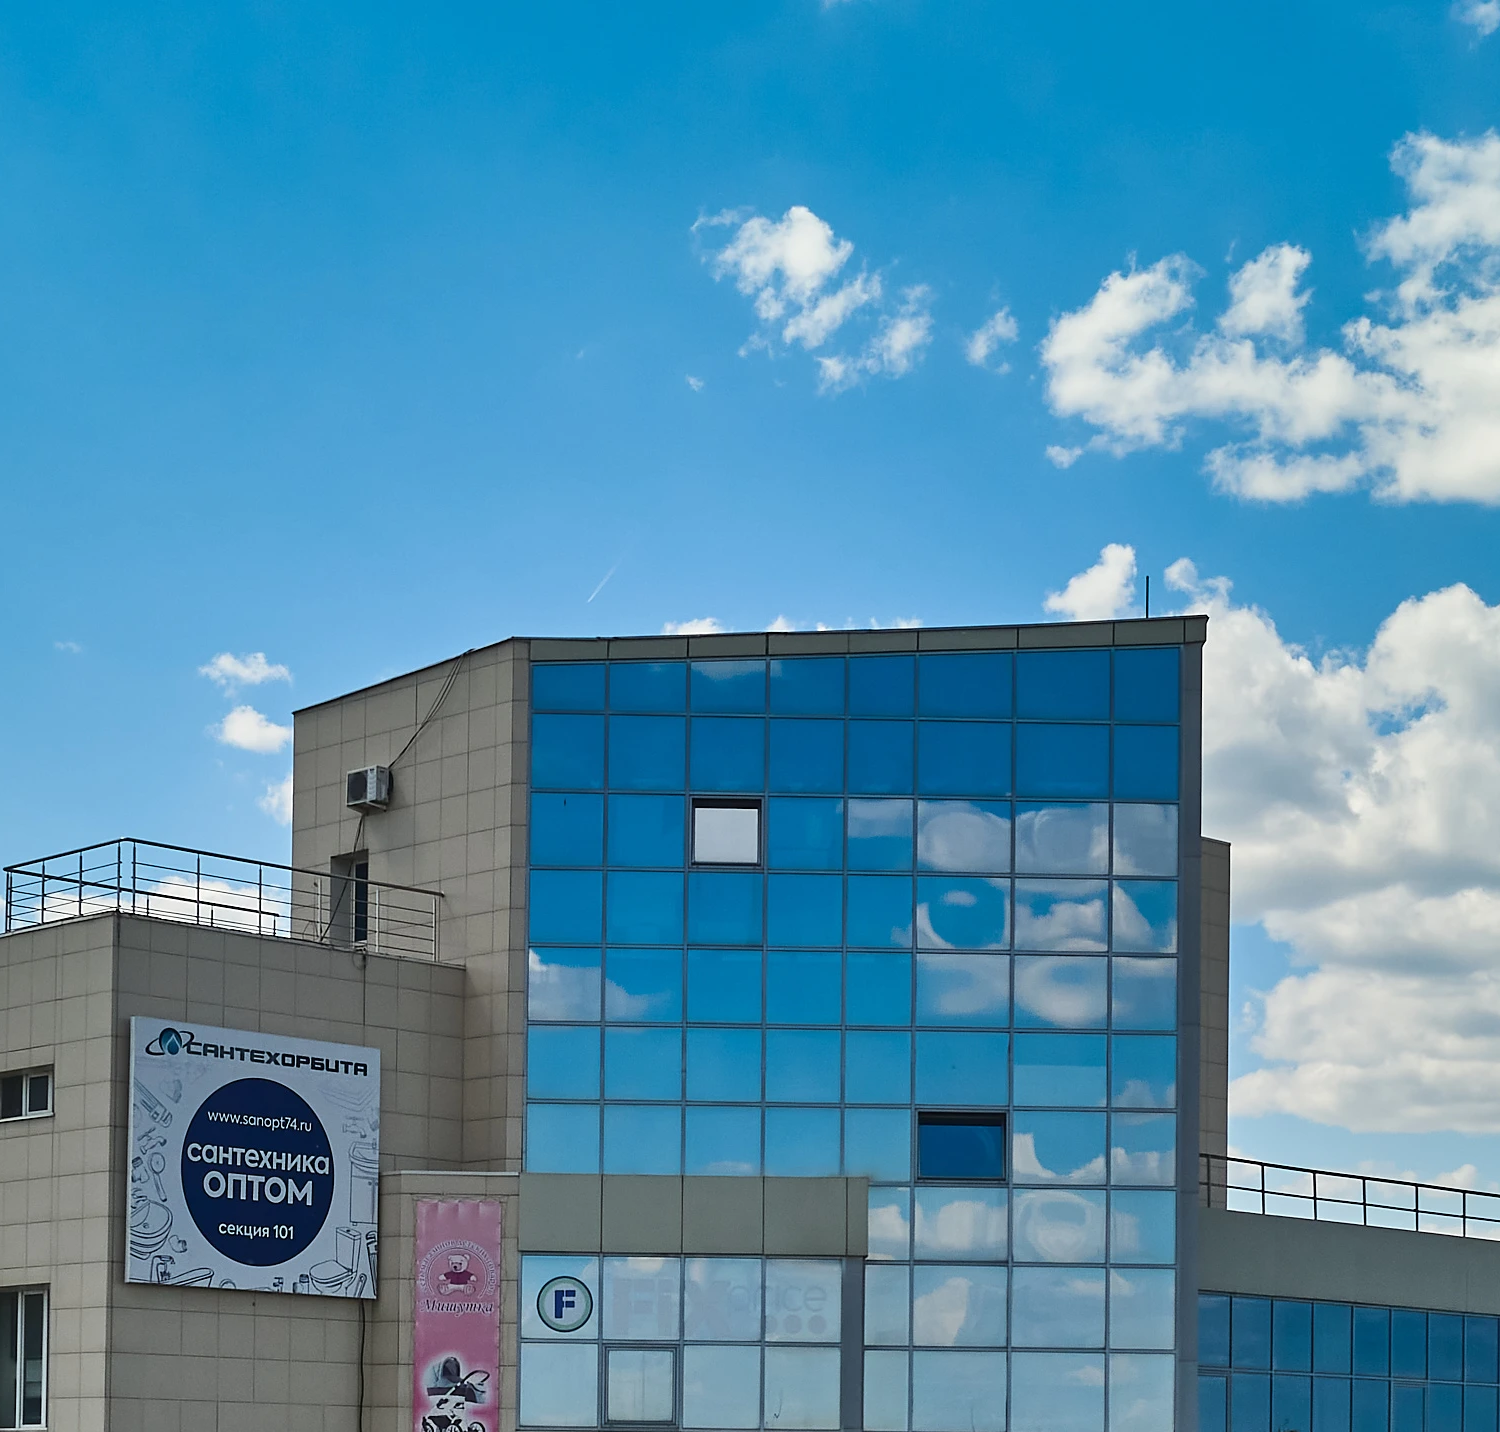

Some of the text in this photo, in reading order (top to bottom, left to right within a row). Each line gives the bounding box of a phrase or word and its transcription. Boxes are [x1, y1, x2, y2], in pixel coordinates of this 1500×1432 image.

[186, 1041, 368, 1077] САНТЕХОРБИТА
[207, 1111, 312, 1133] www.sanopt74.ru
[187, 1142, 330, 1175] сантехника
[203, 1170, 313, 1206] ОПТОМ
[218, 1223, 294, 1240] секция 101
[421, 1299, 494, 1317] Мишутка
[554, 1289, 576, 1319] F
